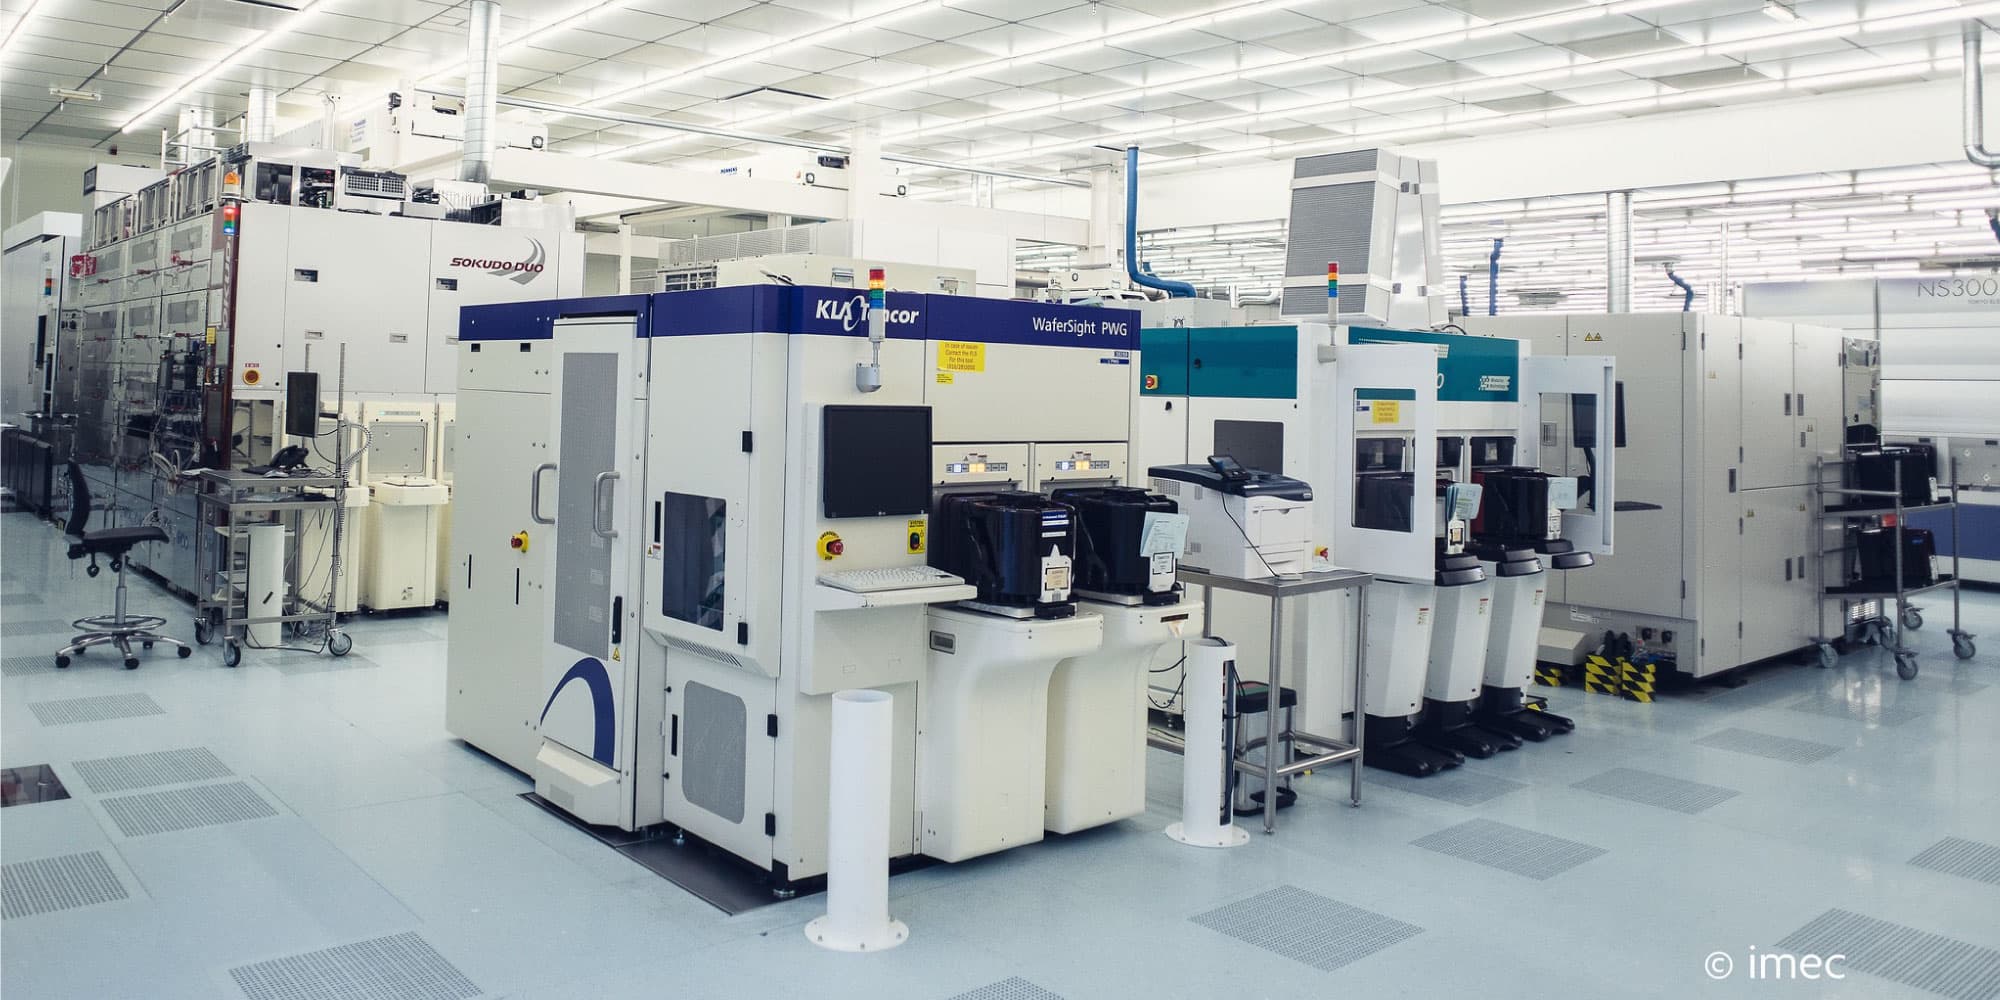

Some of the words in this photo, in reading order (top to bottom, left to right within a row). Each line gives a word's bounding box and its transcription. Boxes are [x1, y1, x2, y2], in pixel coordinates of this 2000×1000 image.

[449, 257, 512, 271] SOKUDO
[514, 262, 544, 273] DUO
[815, 299, 852, 321] KLA
[860, 302, 919, 324] Tcor
[1032, 316, 1096, 337] WaferSight
[1101, 321, 1128, 336] PWG
